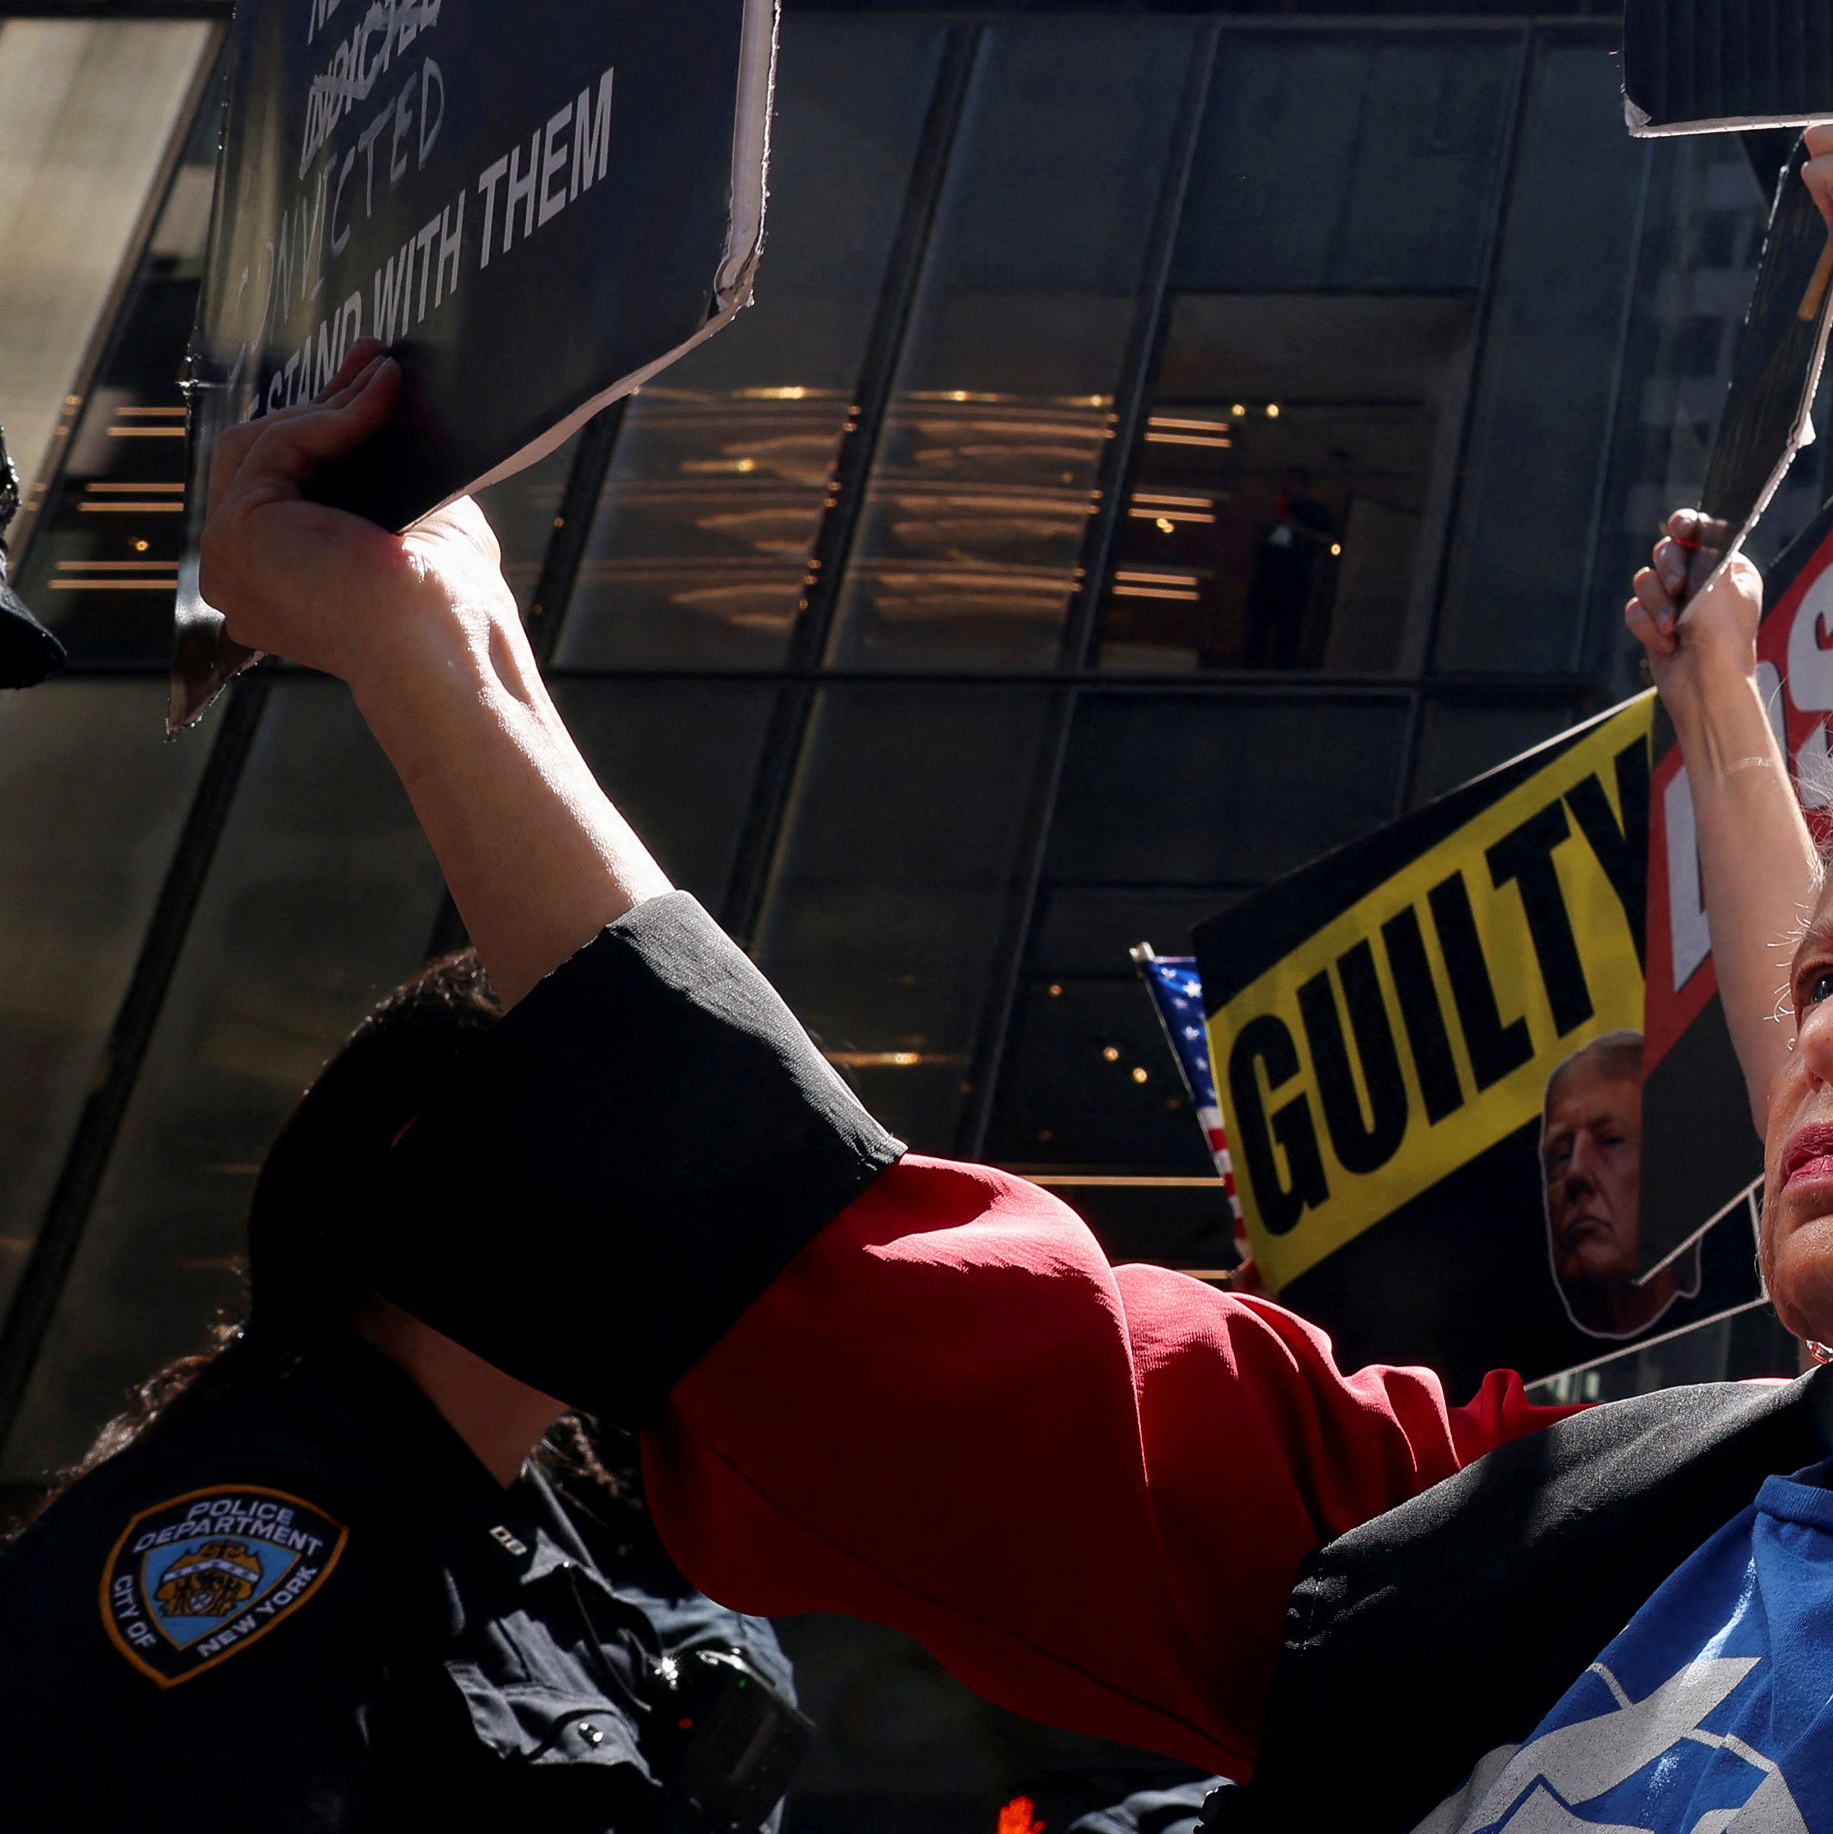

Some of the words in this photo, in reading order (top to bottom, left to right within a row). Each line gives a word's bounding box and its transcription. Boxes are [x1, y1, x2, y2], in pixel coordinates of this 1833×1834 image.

[372, 188, 467, 350] WITH
[477, 65, 614, 270] THEM
[1230, 733, 1651, 1236] GUILTY
[185, 1498, 297, 1527] POLICE
[131, 1517, 324, 1558] DEPARTMENT
[112, 1573, 141, 1620] CITY
[194, 1615, 259, 1660] NEW
[254, 1564, 320, 1617] YORK
[124, 1620, 158, 1650] OF
